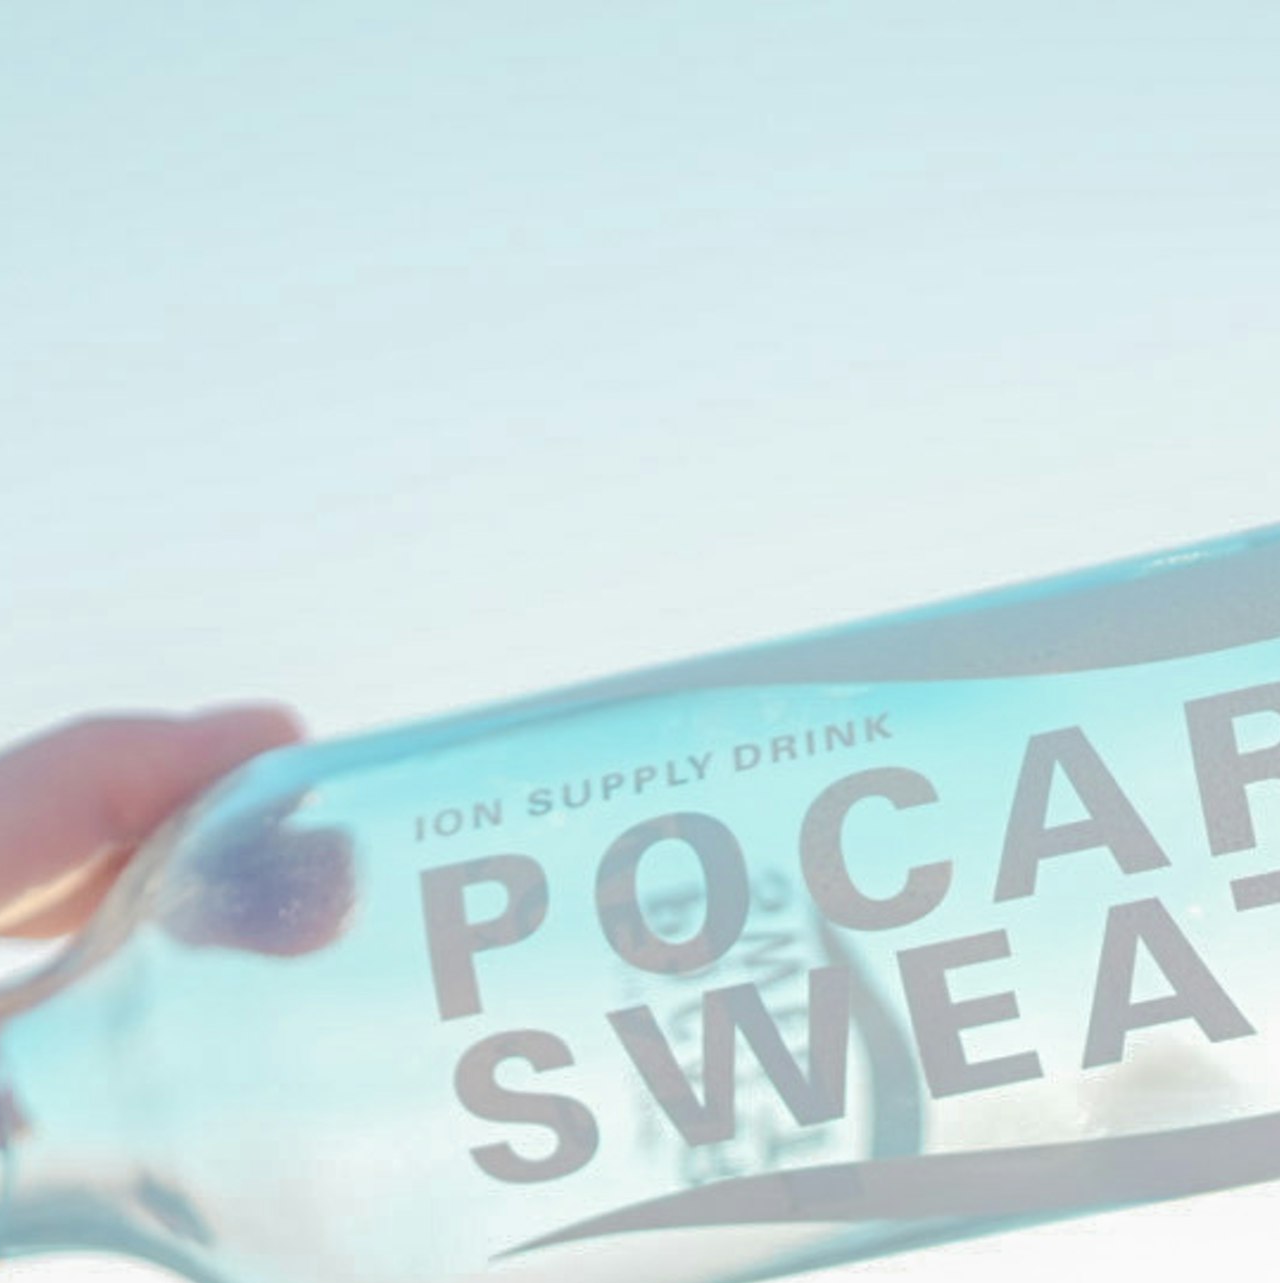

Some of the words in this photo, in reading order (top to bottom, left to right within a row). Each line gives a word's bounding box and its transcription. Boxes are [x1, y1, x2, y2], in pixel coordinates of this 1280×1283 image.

[414, 799, 504, 842] ION
[526, 751, 714, 817] SUPPLY
[734, 712, 894, 772] DRINK
